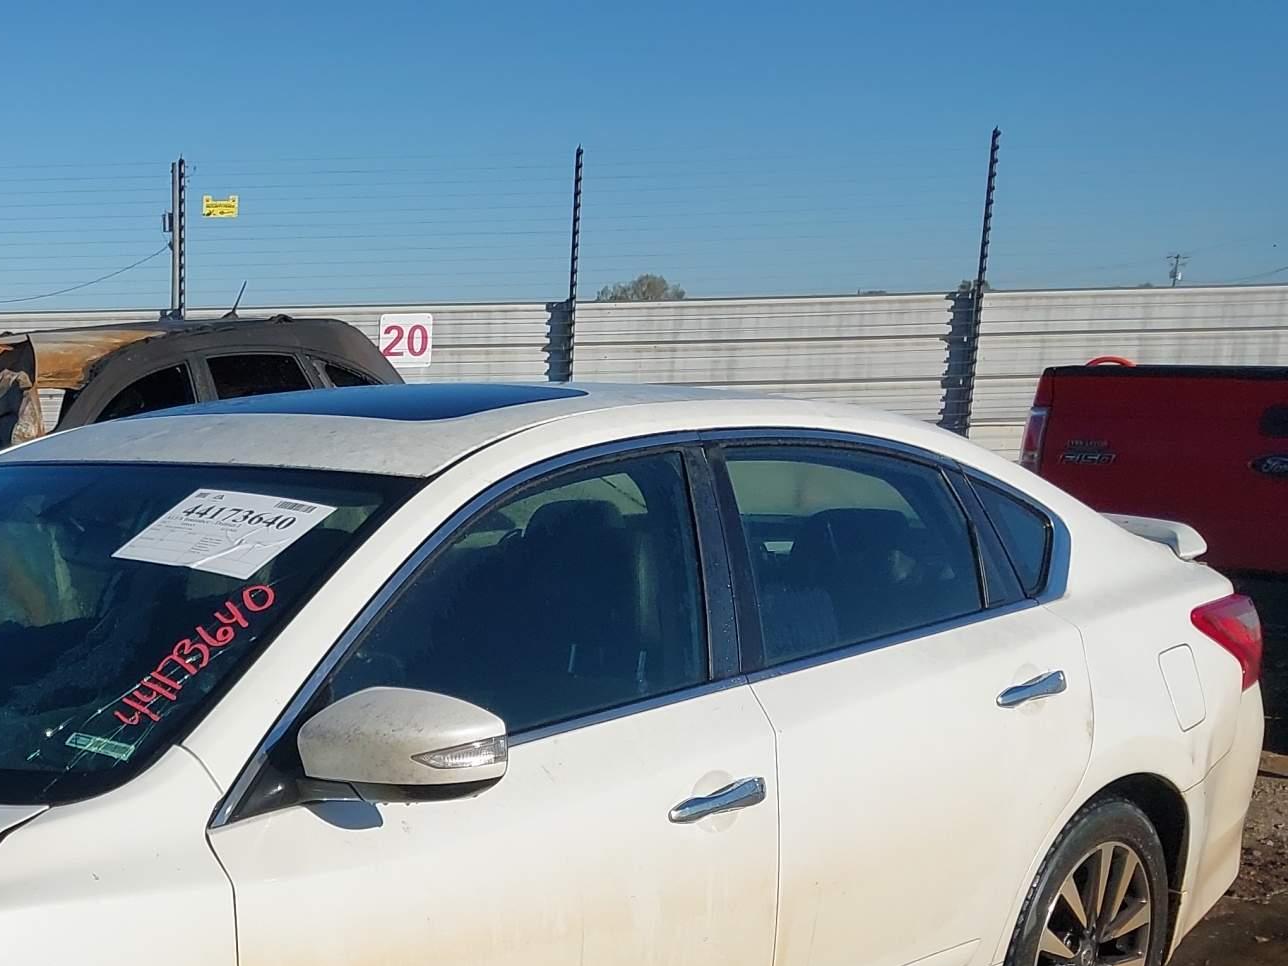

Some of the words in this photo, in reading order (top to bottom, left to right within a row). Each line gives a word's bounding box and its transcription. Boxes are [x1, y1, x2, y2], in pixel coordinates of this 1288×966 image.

[382, 324, 428, 357] 20
[182, 503, 297, 531] 44173640
[113, 584, 276, 723] 44173640
